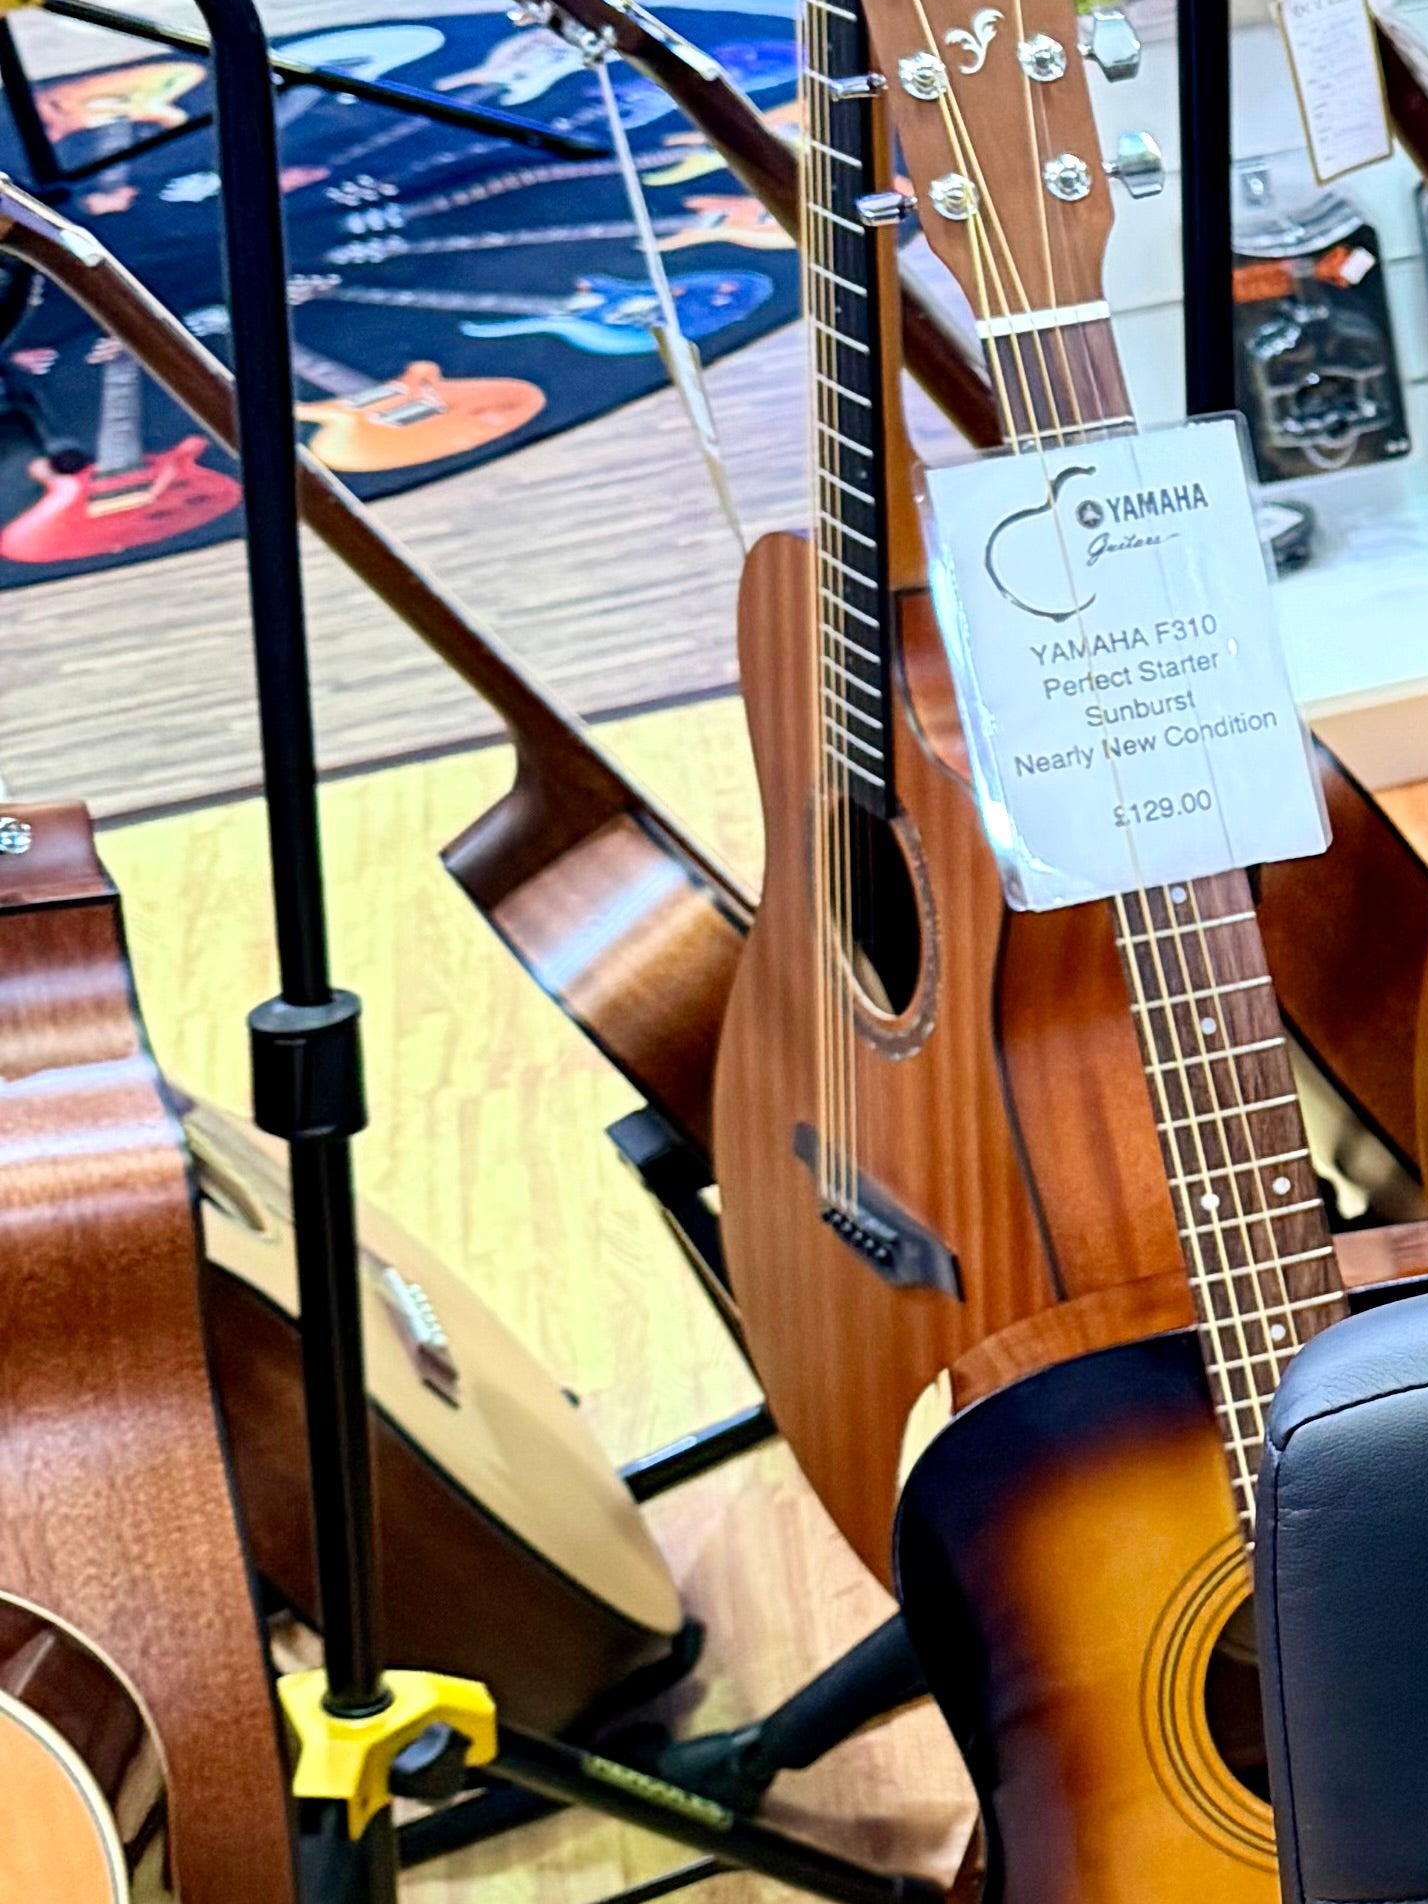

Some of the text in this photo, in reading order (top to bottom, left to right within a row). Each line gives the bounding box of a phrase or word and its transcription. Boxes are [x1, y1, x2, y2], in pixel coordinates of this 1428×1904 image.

[1106, 483, 1208, 523] YAMAHA
[1030, 614, 1217, 666] YAMAHA F310
[1044, 653, 1219, 700] Perfect Starter
[1085, 690, 1195, 727] Sunburst
[1015, 709, 1278, 777] Nearly New Condition
[1114, 790, 1213, 827] £129.00
